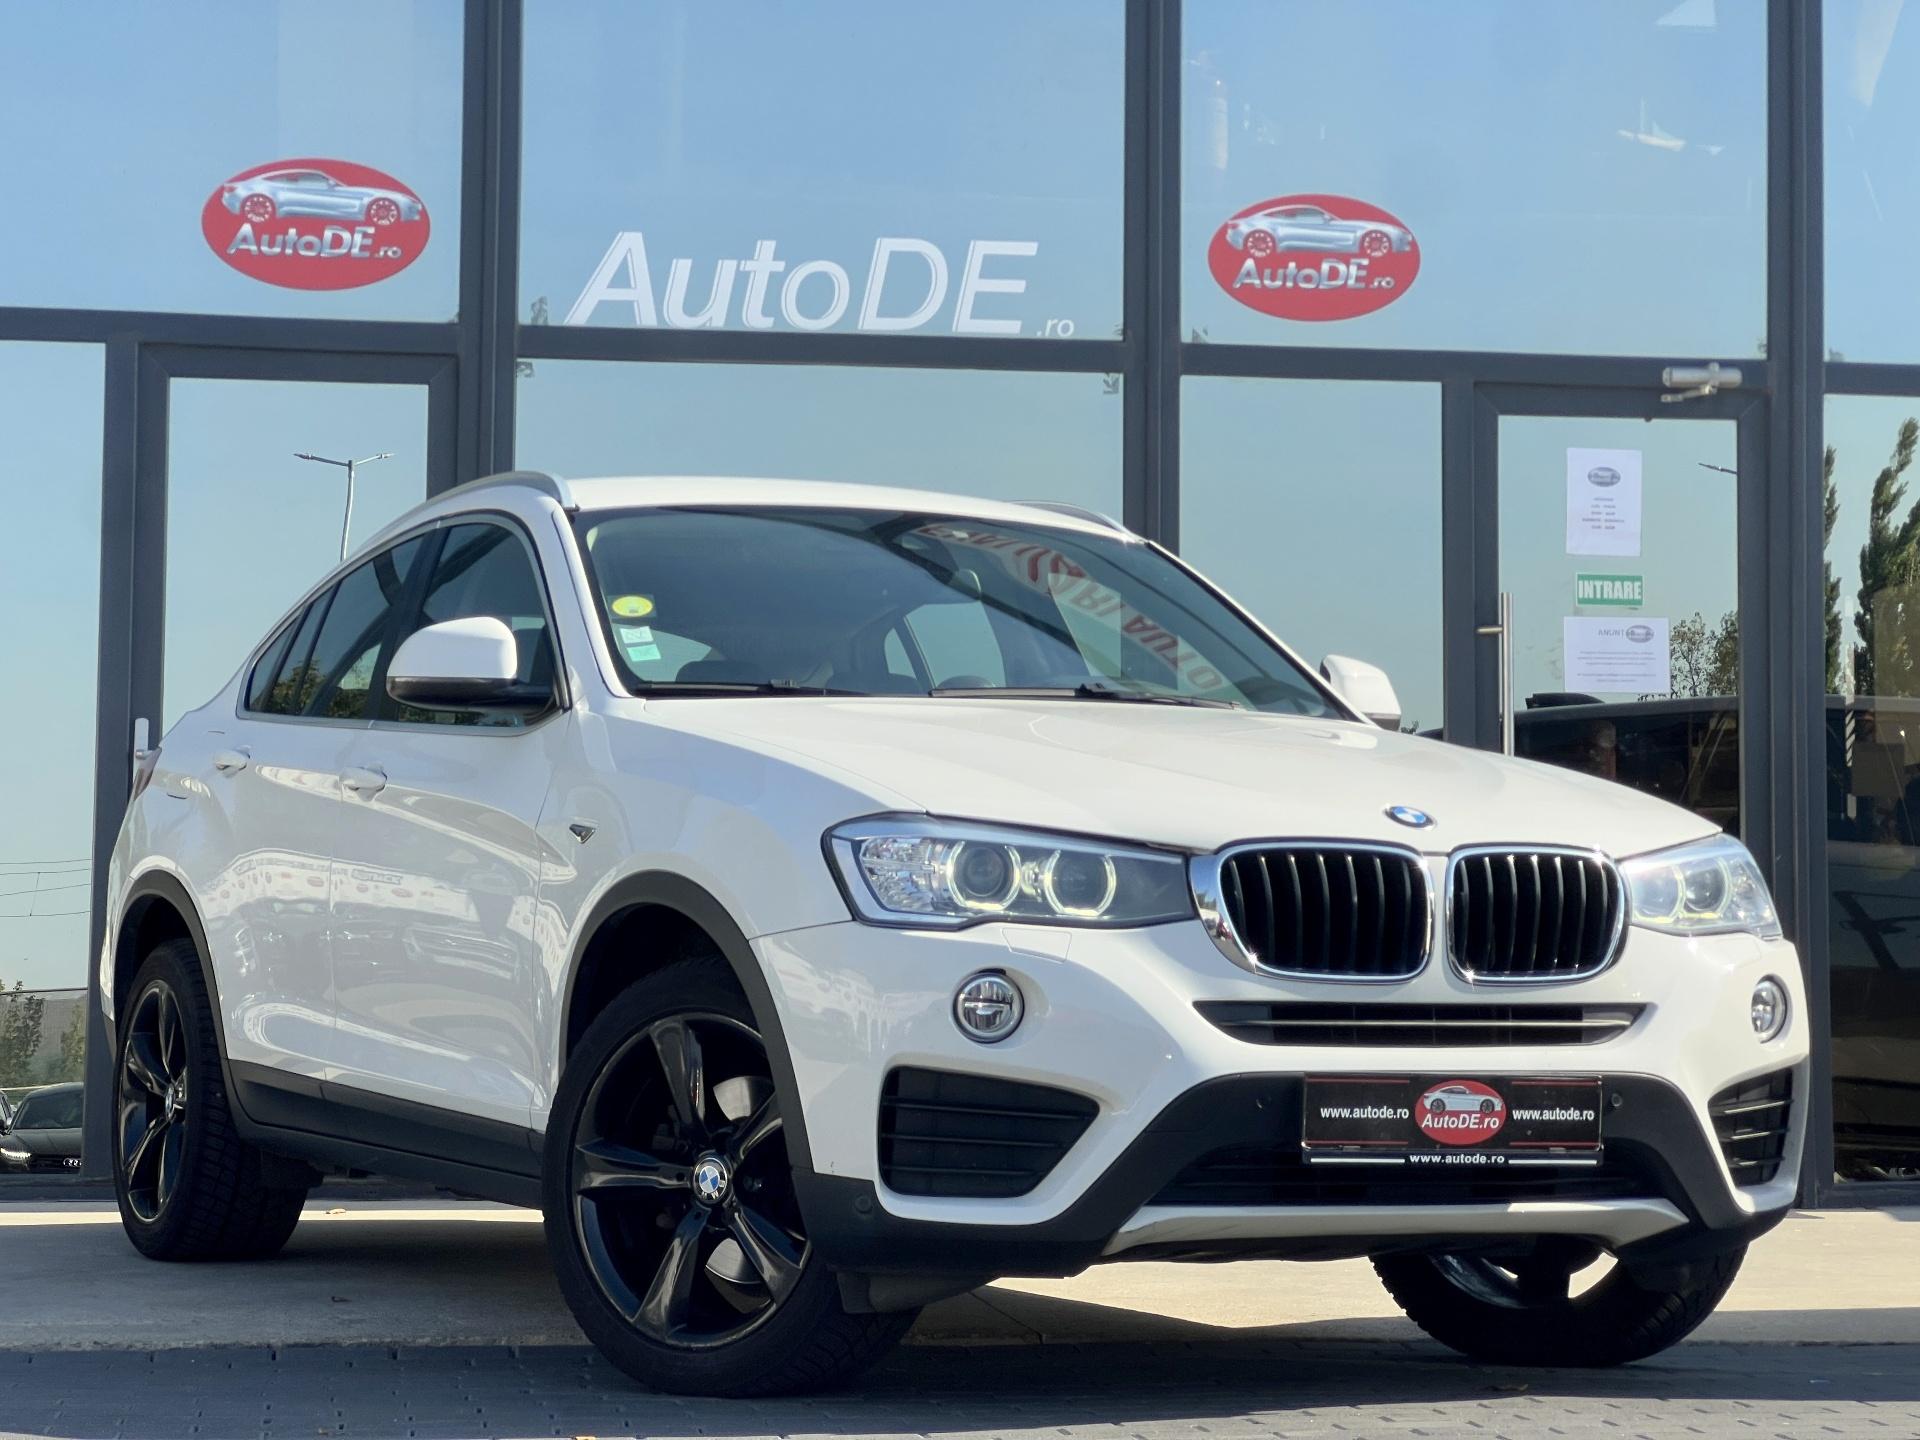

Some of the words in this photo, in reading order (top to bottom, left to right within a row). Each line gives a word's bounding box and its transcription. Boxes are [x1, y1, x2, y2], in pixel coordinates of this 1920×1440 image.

[1578, 580, 1642, 600] INTRARE
[1320, 1105, 1410, 1120] www.autode.ro
[1512, 1107, 1595, 1121] www.autode.ro
[1421, 1112, 1500, 1130] AutoDE.ro
[1408, 1152, 1506, 1165] www.autode.ro
